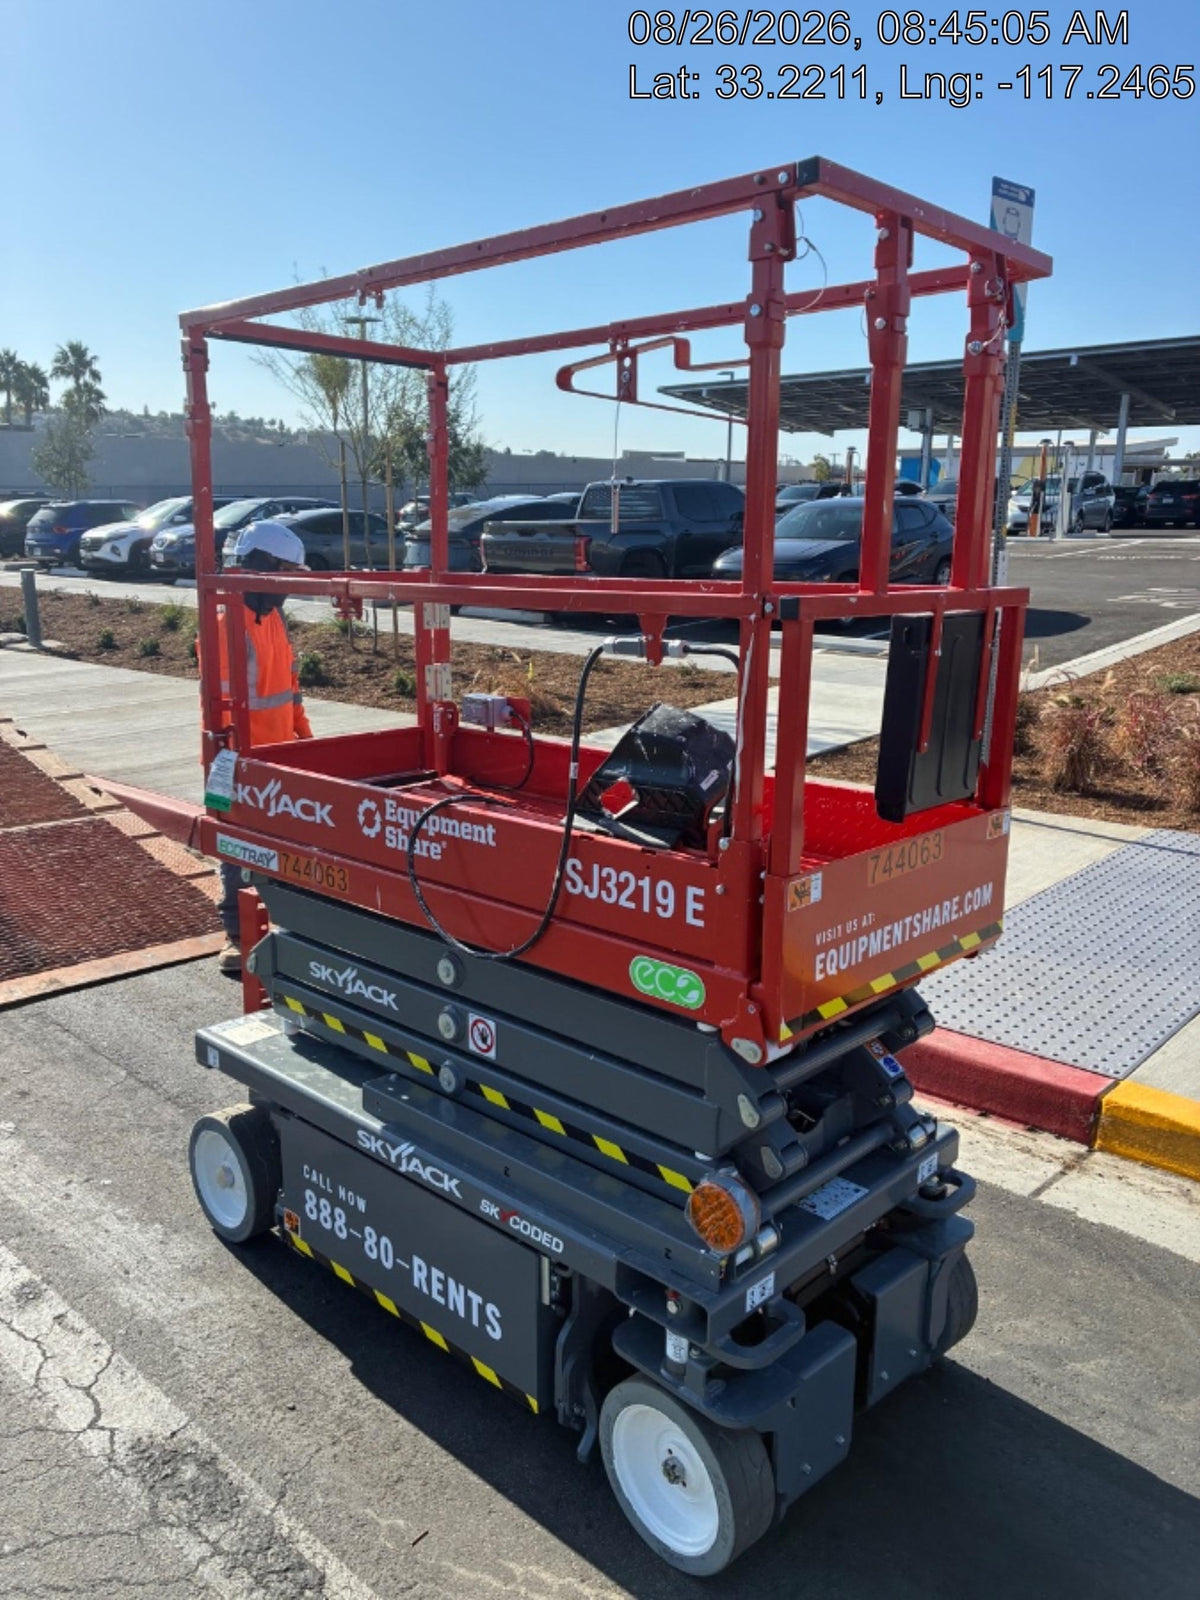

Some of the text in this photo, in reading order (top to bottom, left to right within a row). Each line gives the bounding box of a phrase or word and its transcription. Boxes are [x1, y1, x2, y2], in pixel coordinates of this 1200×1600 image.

[219, 838, 277, 868] ECOTRAY
[282, 852, 348, 892] 744063
[868, 831, 943, 886] 744063
[565, 857, 705, 928] SJ3219 E
[814, 881, 994, 983] EQUIPMENTSHARE.COM
[815, 912, 876, 946] VISIT US AT:
[309, 961, 399, 1011] SKYJACK
[303, 1164, 367, 1213] CALL NOW
[356, 1129, 463, 1199] SKYJACK
[304, 1188, 503, 1341] 888-80-RENTS
